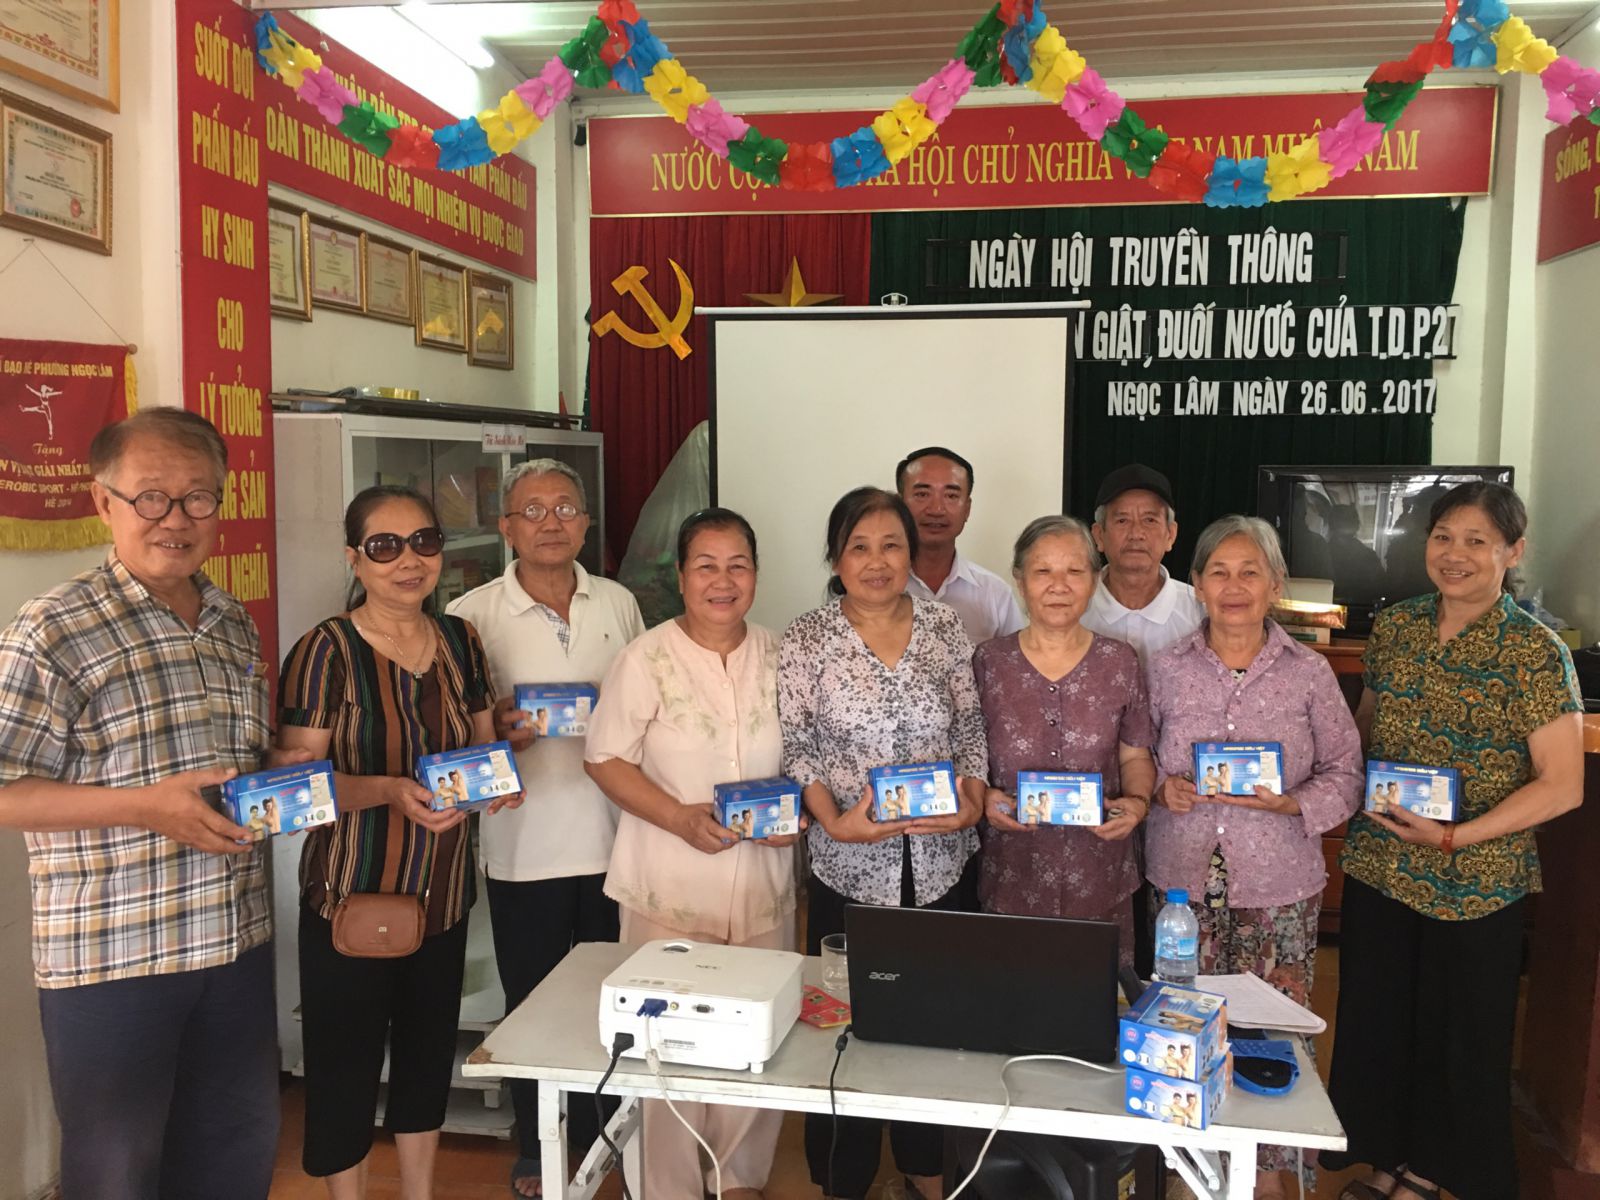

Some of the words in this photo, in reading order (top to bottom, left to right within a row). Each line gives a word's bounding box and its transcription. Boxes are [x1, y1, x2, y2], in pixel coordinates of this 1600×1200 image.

[195, 16, 229, 88] SUỐT
[192, 103, 231, 177] PHẤN
[233, 117, 259, 188] ĐẤU
[651, 139, 721, 191] NƯỚC
[907, 133, 956, 198] HỘI
[963, 126, 1020, 185] CHỦ
[302, 123, 350, 183] THÀNH
[413, 177, 434, 224] MỌI
[436, 188, 468, 236] NHIỆM
[469, 204, 481, 244] VỤ
[483, 210, 504, 252] ĐƯỢC
[506, 222, 524, 256] GIAO
[202, 204, 219, 260] HY
[223, 212, 254, 270] SINH
[969, 232, 1037, 289] NGÀY
[1050, 232, 1094, 294] HỘI
[1109, 227, 1209, 286] TRUYỀN
[1228, 225, 1313, 285] THÔNG
[217, 297, 244, 352] CHO
[1157, 301, 1217, 359] ĐUỐI
[1224, 300, 1296, 359] NƯỚC
[1307, 294, 1358, 359] CỦA
[219, 364, 262, 437] TƯỞNG
[1107, 381, 1161, 421] NGỌC
[1174, 375, 1219, 416] LÂM
[1233, 376, 1289, 416] NGÀY
[240, 449, 267, 519] SẢN
[868, 971, 900, 981] acer
